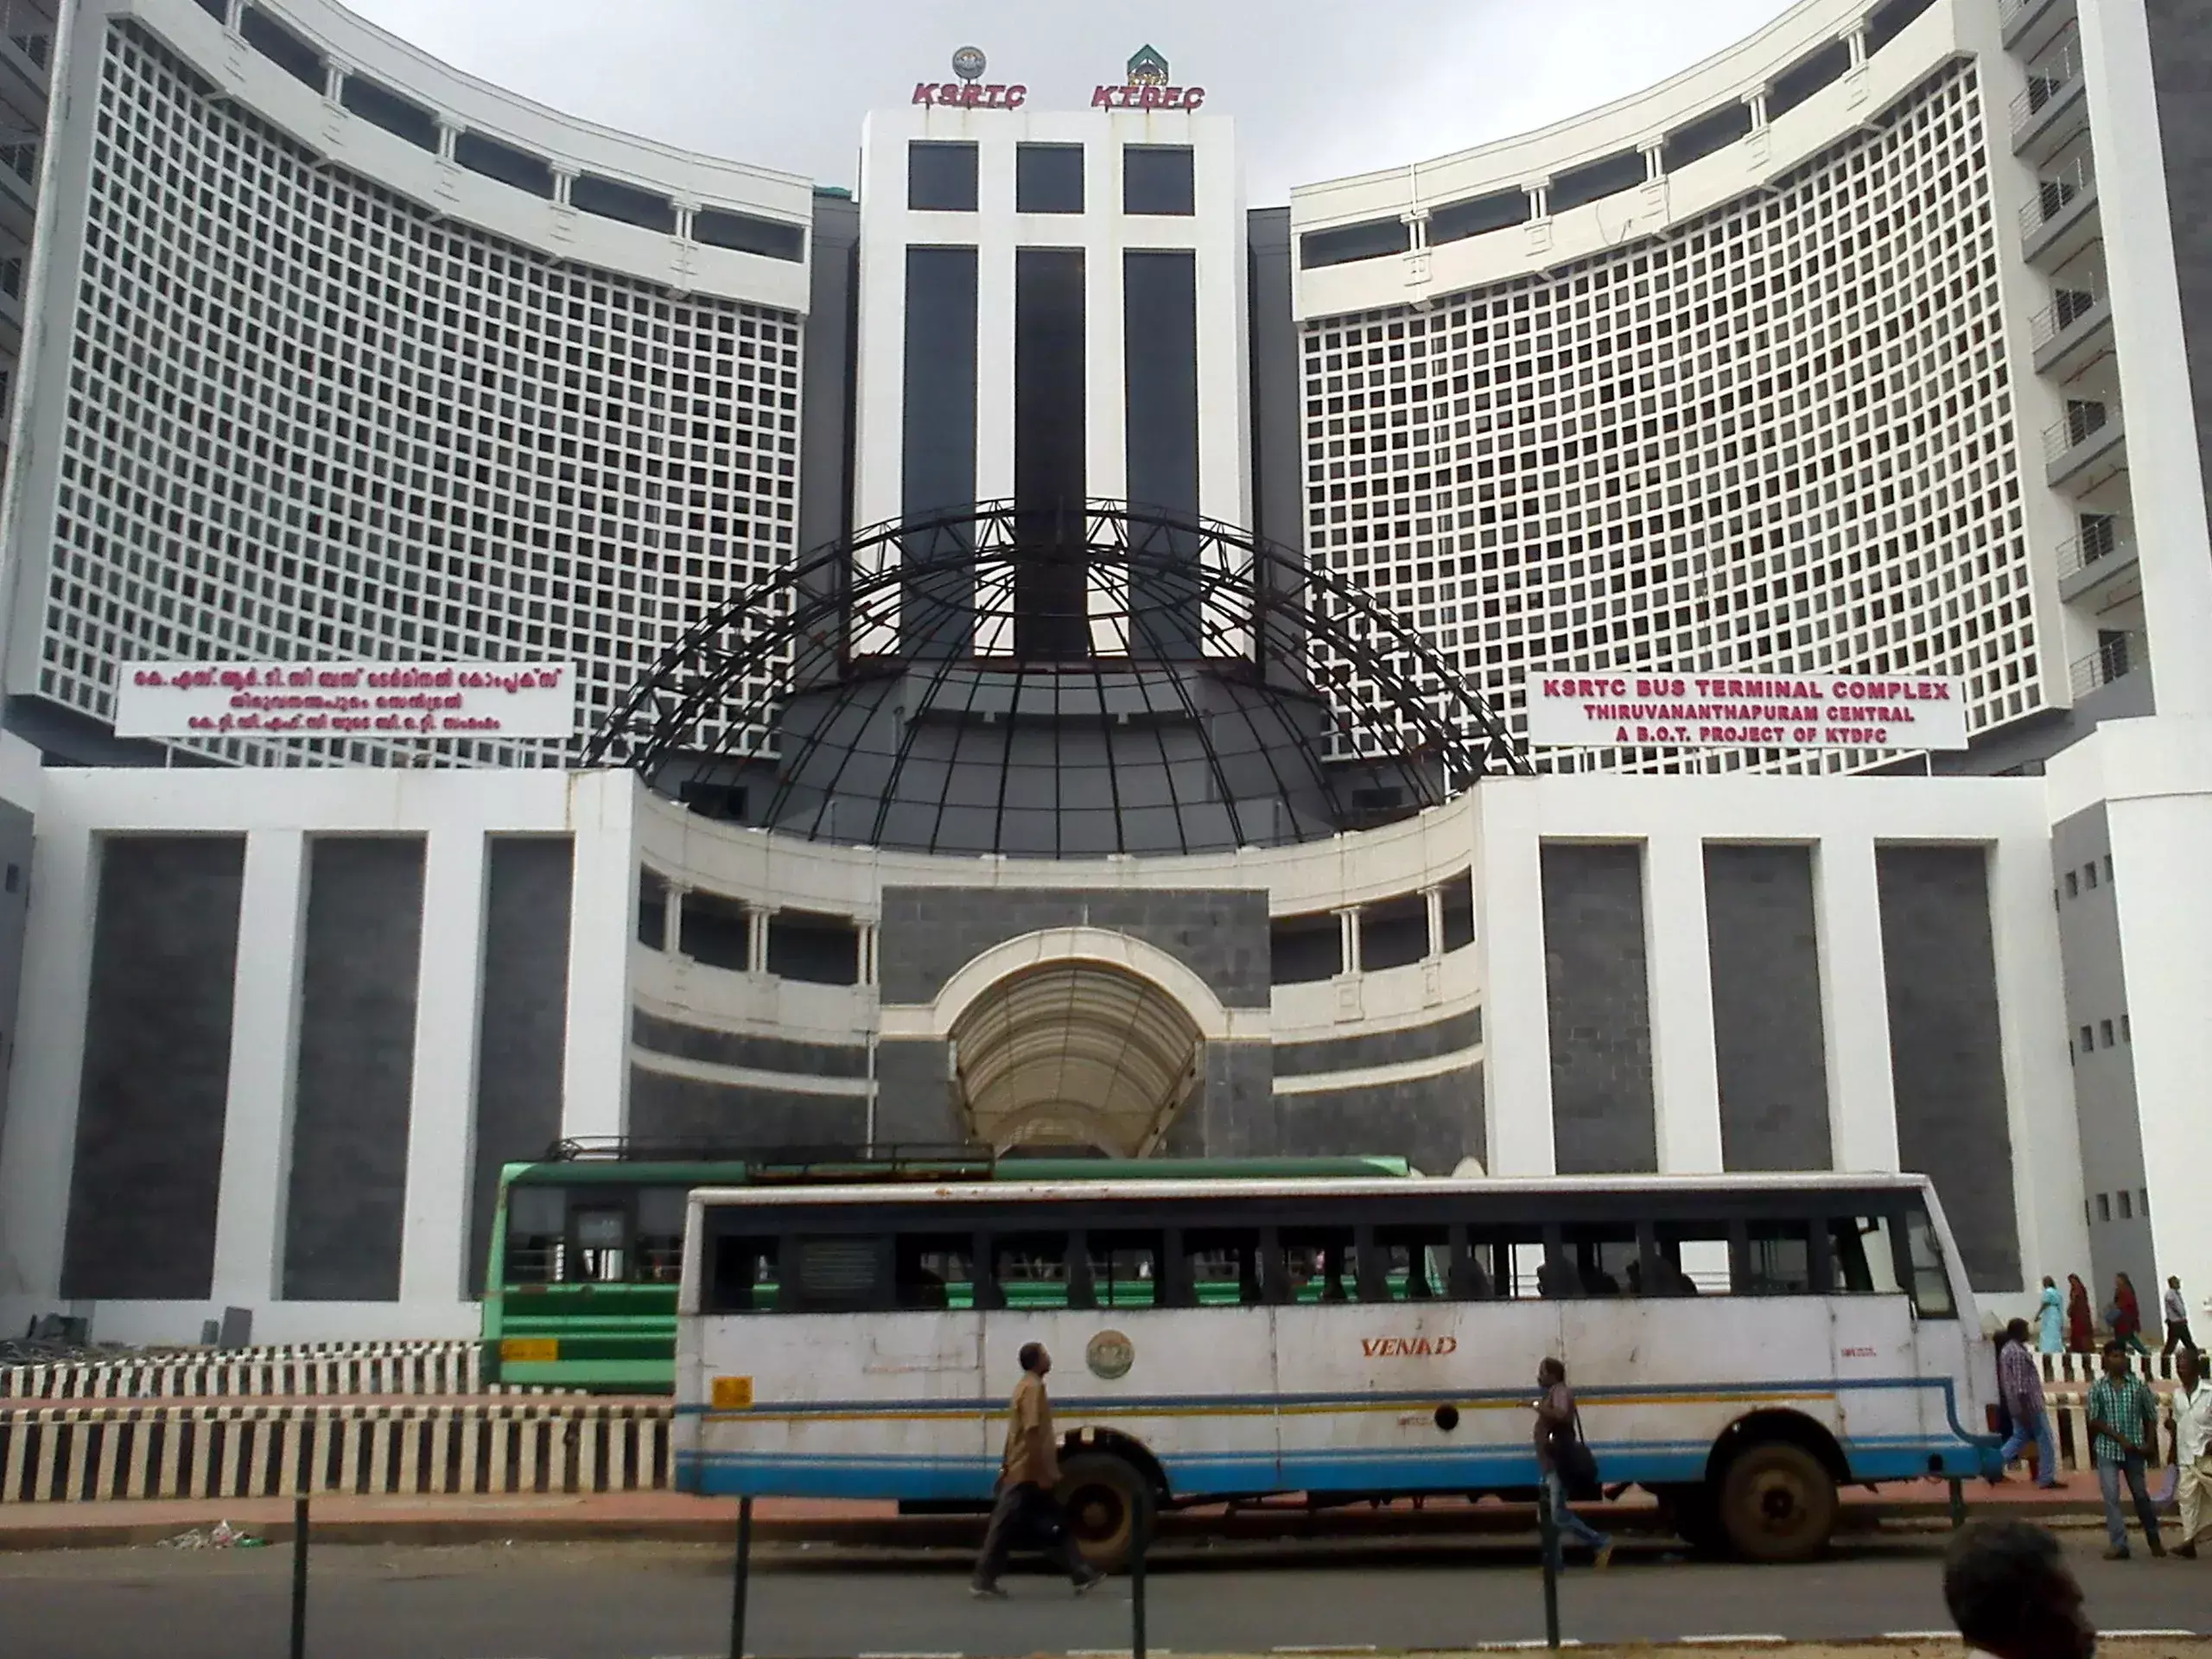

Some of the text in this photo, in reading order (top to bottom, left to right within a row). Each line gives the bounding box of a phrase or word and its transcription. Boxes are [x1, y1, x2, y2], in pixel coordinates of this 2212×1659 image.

[912, 82, 1027, 108] KSRTC
[1090, 85, 1205, 109] KTDFC
[1542, 678, 1950, 701] KSRTC BUS TERMINAL COMPLEX
[1584, 703, 1916, 723] THIRUVANANTHAPURAM CENTRAL
[1616, 726, 1888, 744] A B.O.T. PROJECT OF KTDFC
[1361, 1336, 1458, 1357] VENAD
